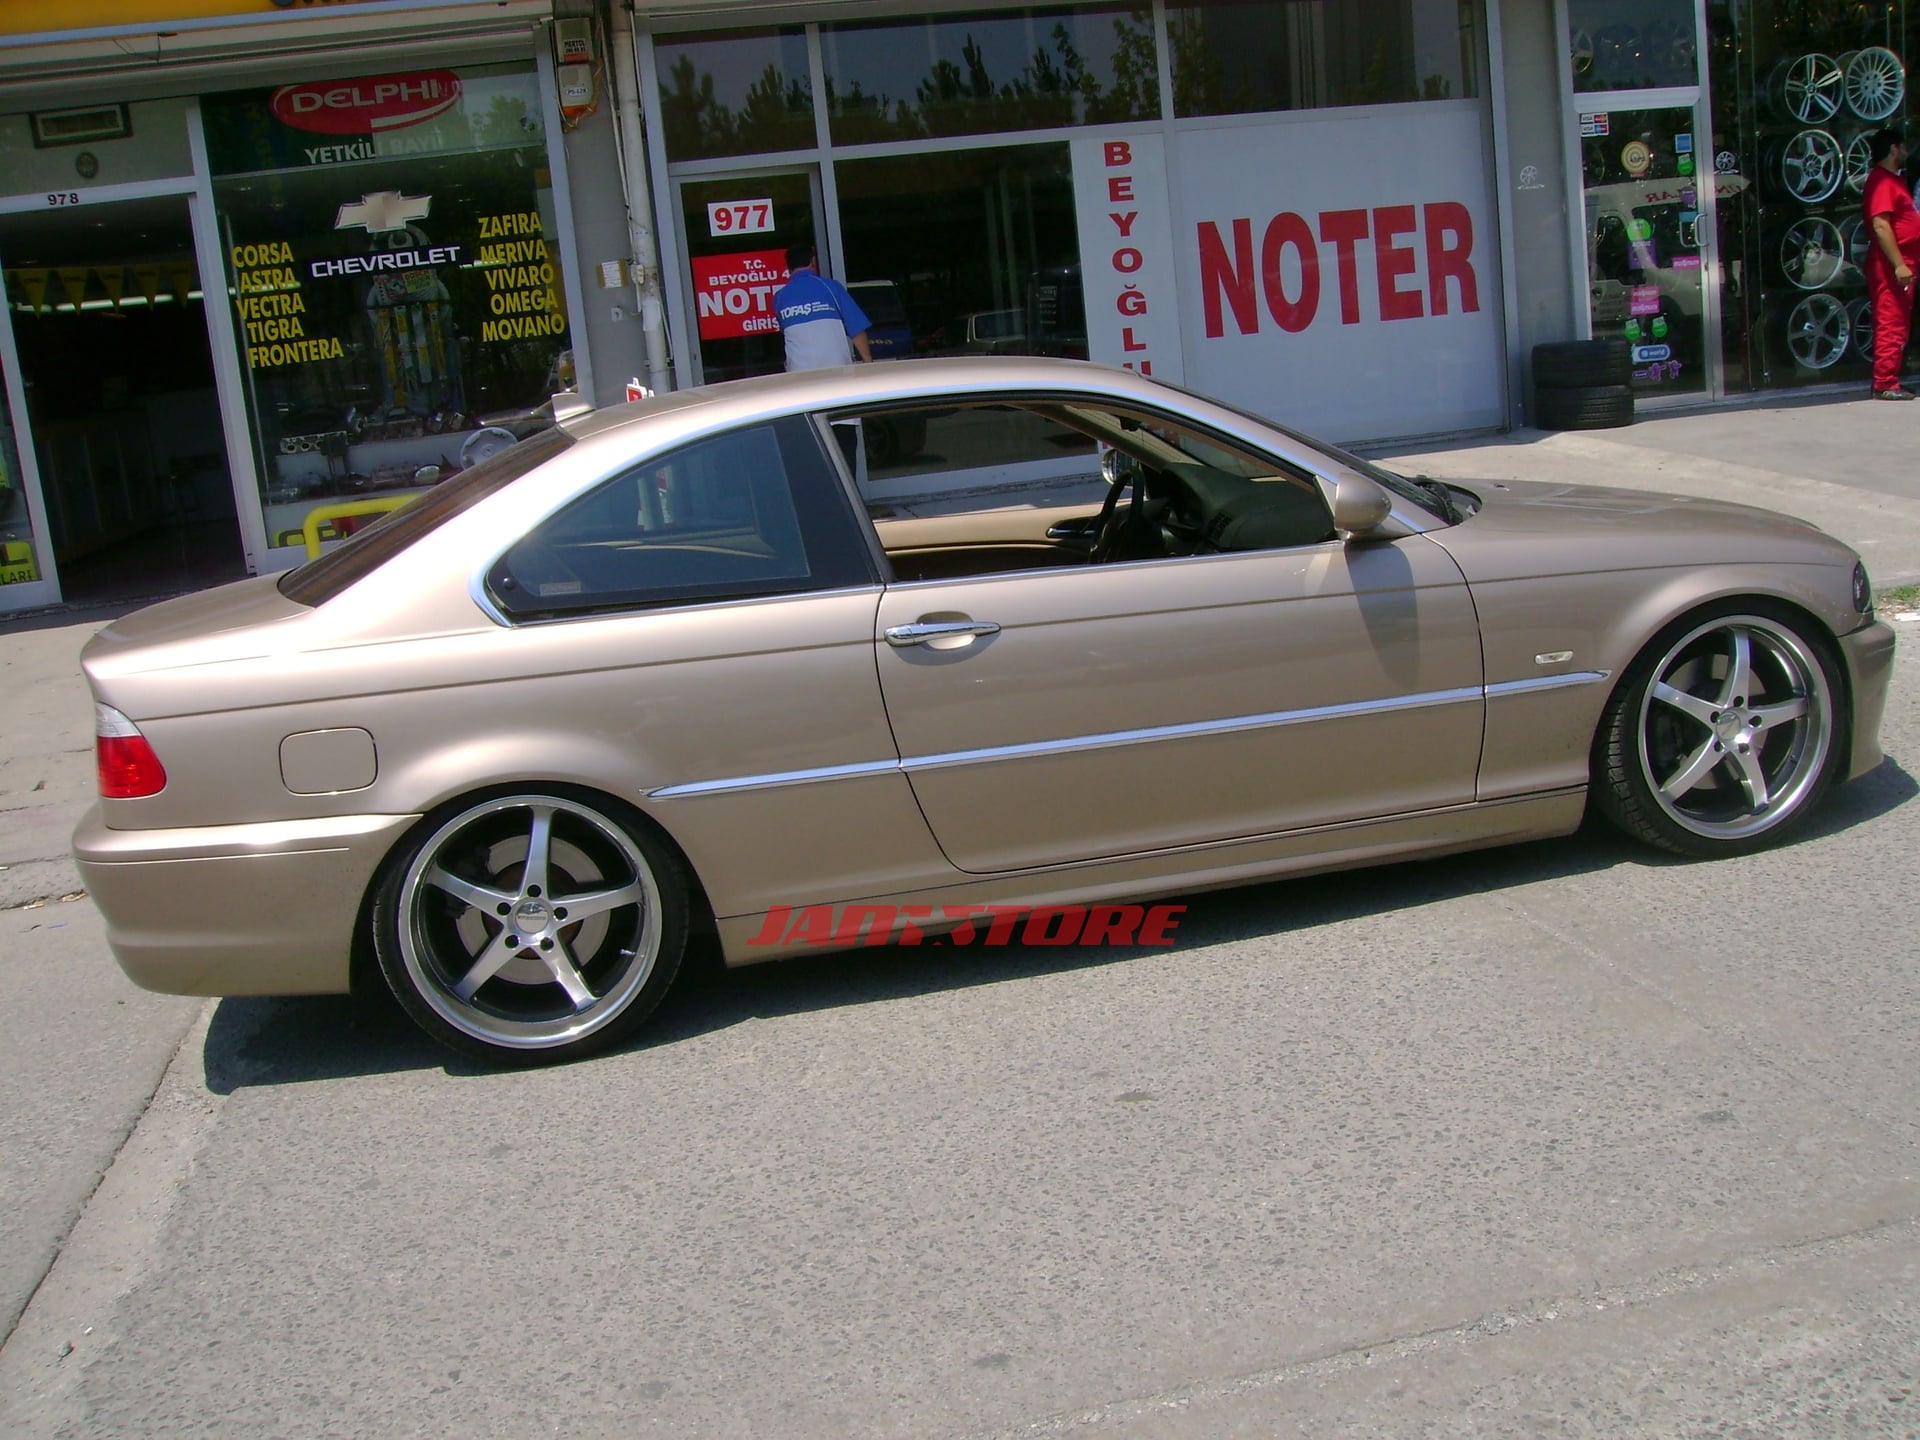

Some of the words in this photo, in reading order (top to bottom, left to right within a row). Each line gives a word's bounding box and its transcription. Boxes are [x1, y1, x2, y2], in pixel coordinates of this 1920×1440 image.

[292, 79, 440, 113] DELPHI
[47, 193, 80, 206] 978
[478, 211, 544, 239] ZAFIRA
[714, 204, 769, 231] 977
[232, 242, 295, 268] CORSA
[311, 246, 461, 278] CHEVROLET
[480, 239, 549, 265] MERIVA
[743, 259, 766, 269] T.C.
[240, 267, 298, 293] ASTRA
[485, 263, 555, 291] VIVARO
[709, 270, 778, 286] BEYOĞLU
[1197, 201, 1480, 338] NOTER
[235, 292, 306, 320] VECTRA
[490, 288, 559, 316] OMEGA
[698, 284, 788, 318] NOT
[780, 303, 812, 320] TOFAŞ
[247, 316, 305, 343] TIGRA
[482, 313, 566, 343] MOVANO
[248, 337, 345, 369] FRONTERA
